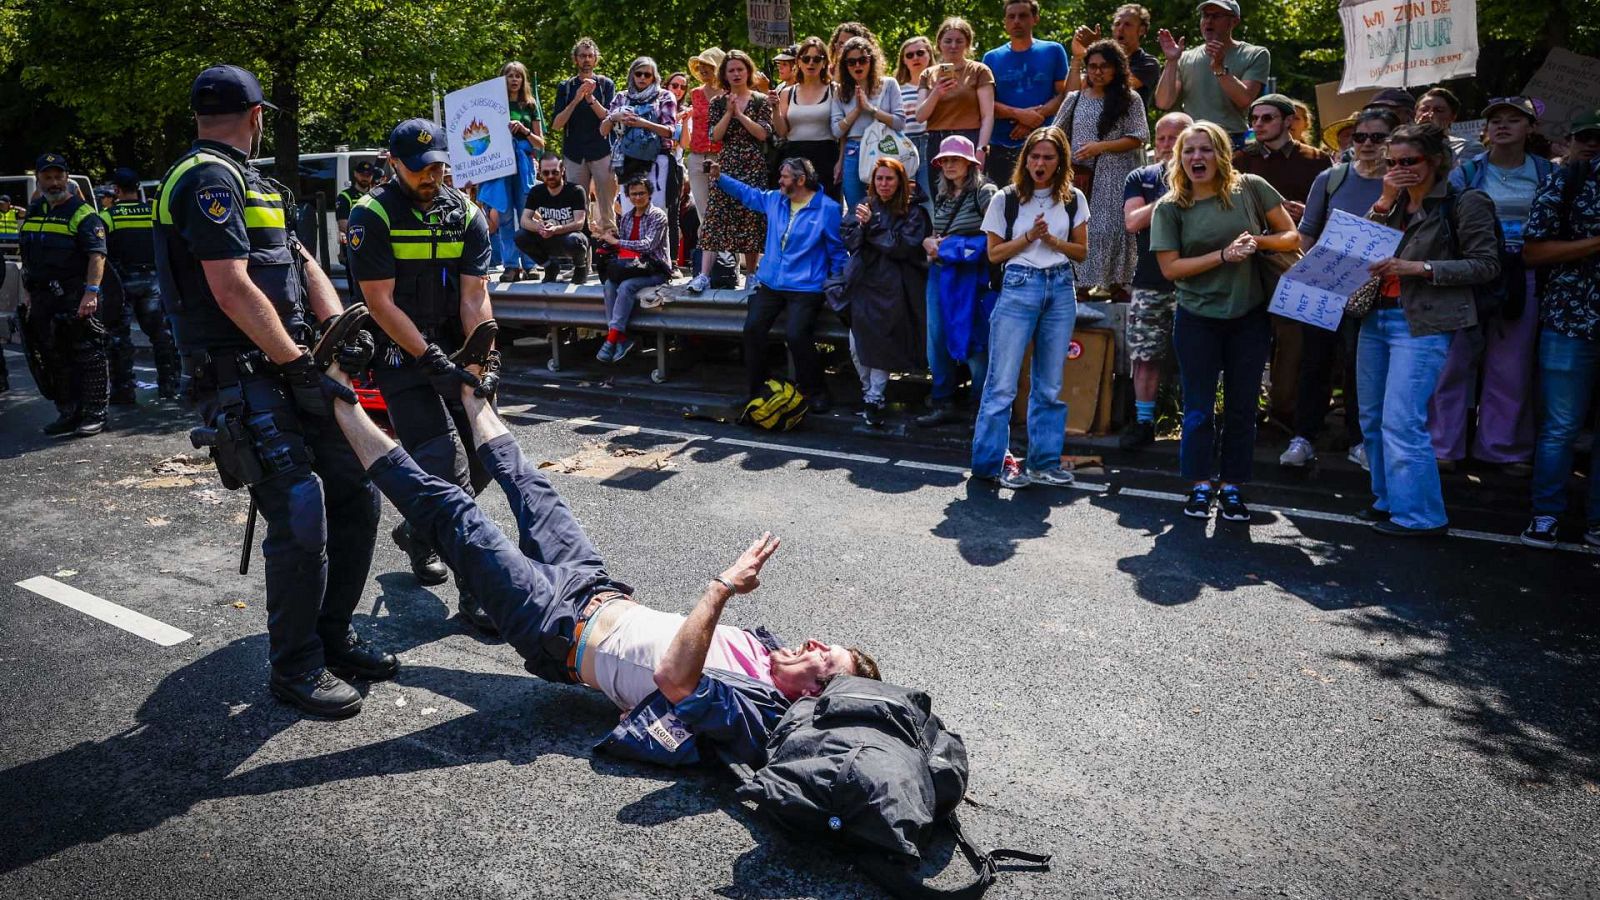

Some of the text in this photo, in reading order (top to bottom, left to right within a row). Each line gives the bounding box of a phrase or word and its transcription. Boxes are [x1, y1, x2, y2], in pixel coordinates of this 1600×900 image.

[1363, 0, 1451, 29] WIJ ZIJN DE
[1367, 18, 1452, 59] NATUUR
[469, 155, 488, 168] LANGER
[489, 152, 501, 161] VAN
[538, 206, 573, 221] CHOOSE
[1296, 293, 1310, 313] MET
